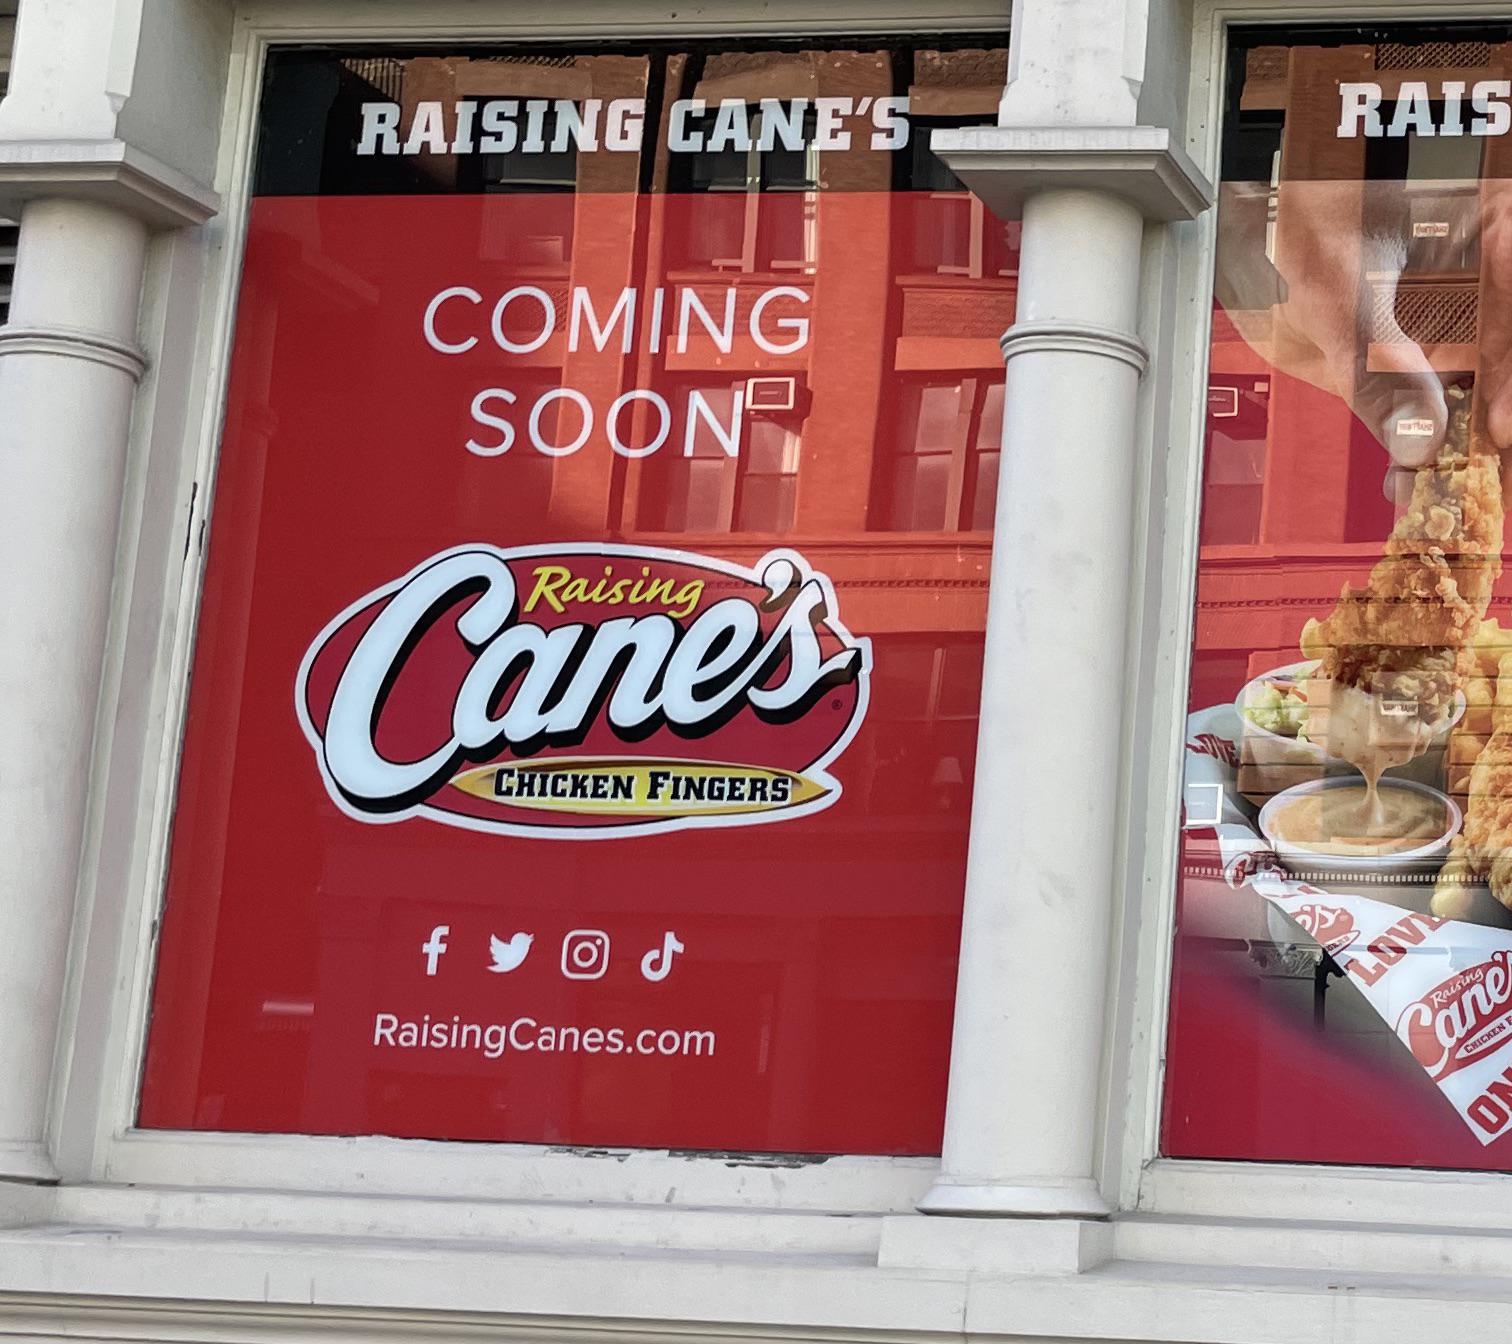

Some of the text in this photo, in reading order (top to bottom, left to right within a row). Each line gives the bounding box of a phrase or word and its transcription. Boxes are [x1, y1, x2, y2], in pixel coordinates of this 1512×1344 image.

[357, 96, 911, 155] RAISING CANE'S
[423, 285, 810, 355] COMING
[465, 387, 744, 458] SOON
[524, 565, 705, 618] Raising
[324, 550, 862, 808] Cane's
[493, 767, 794, 804] CHICKEN FINGERS
[1430, 967, 1485, 1009] Raising
[373, 1013, 716, 1058] RaisingCanes.com
[1463, 1023, 1506, 1055] CHICKEN
